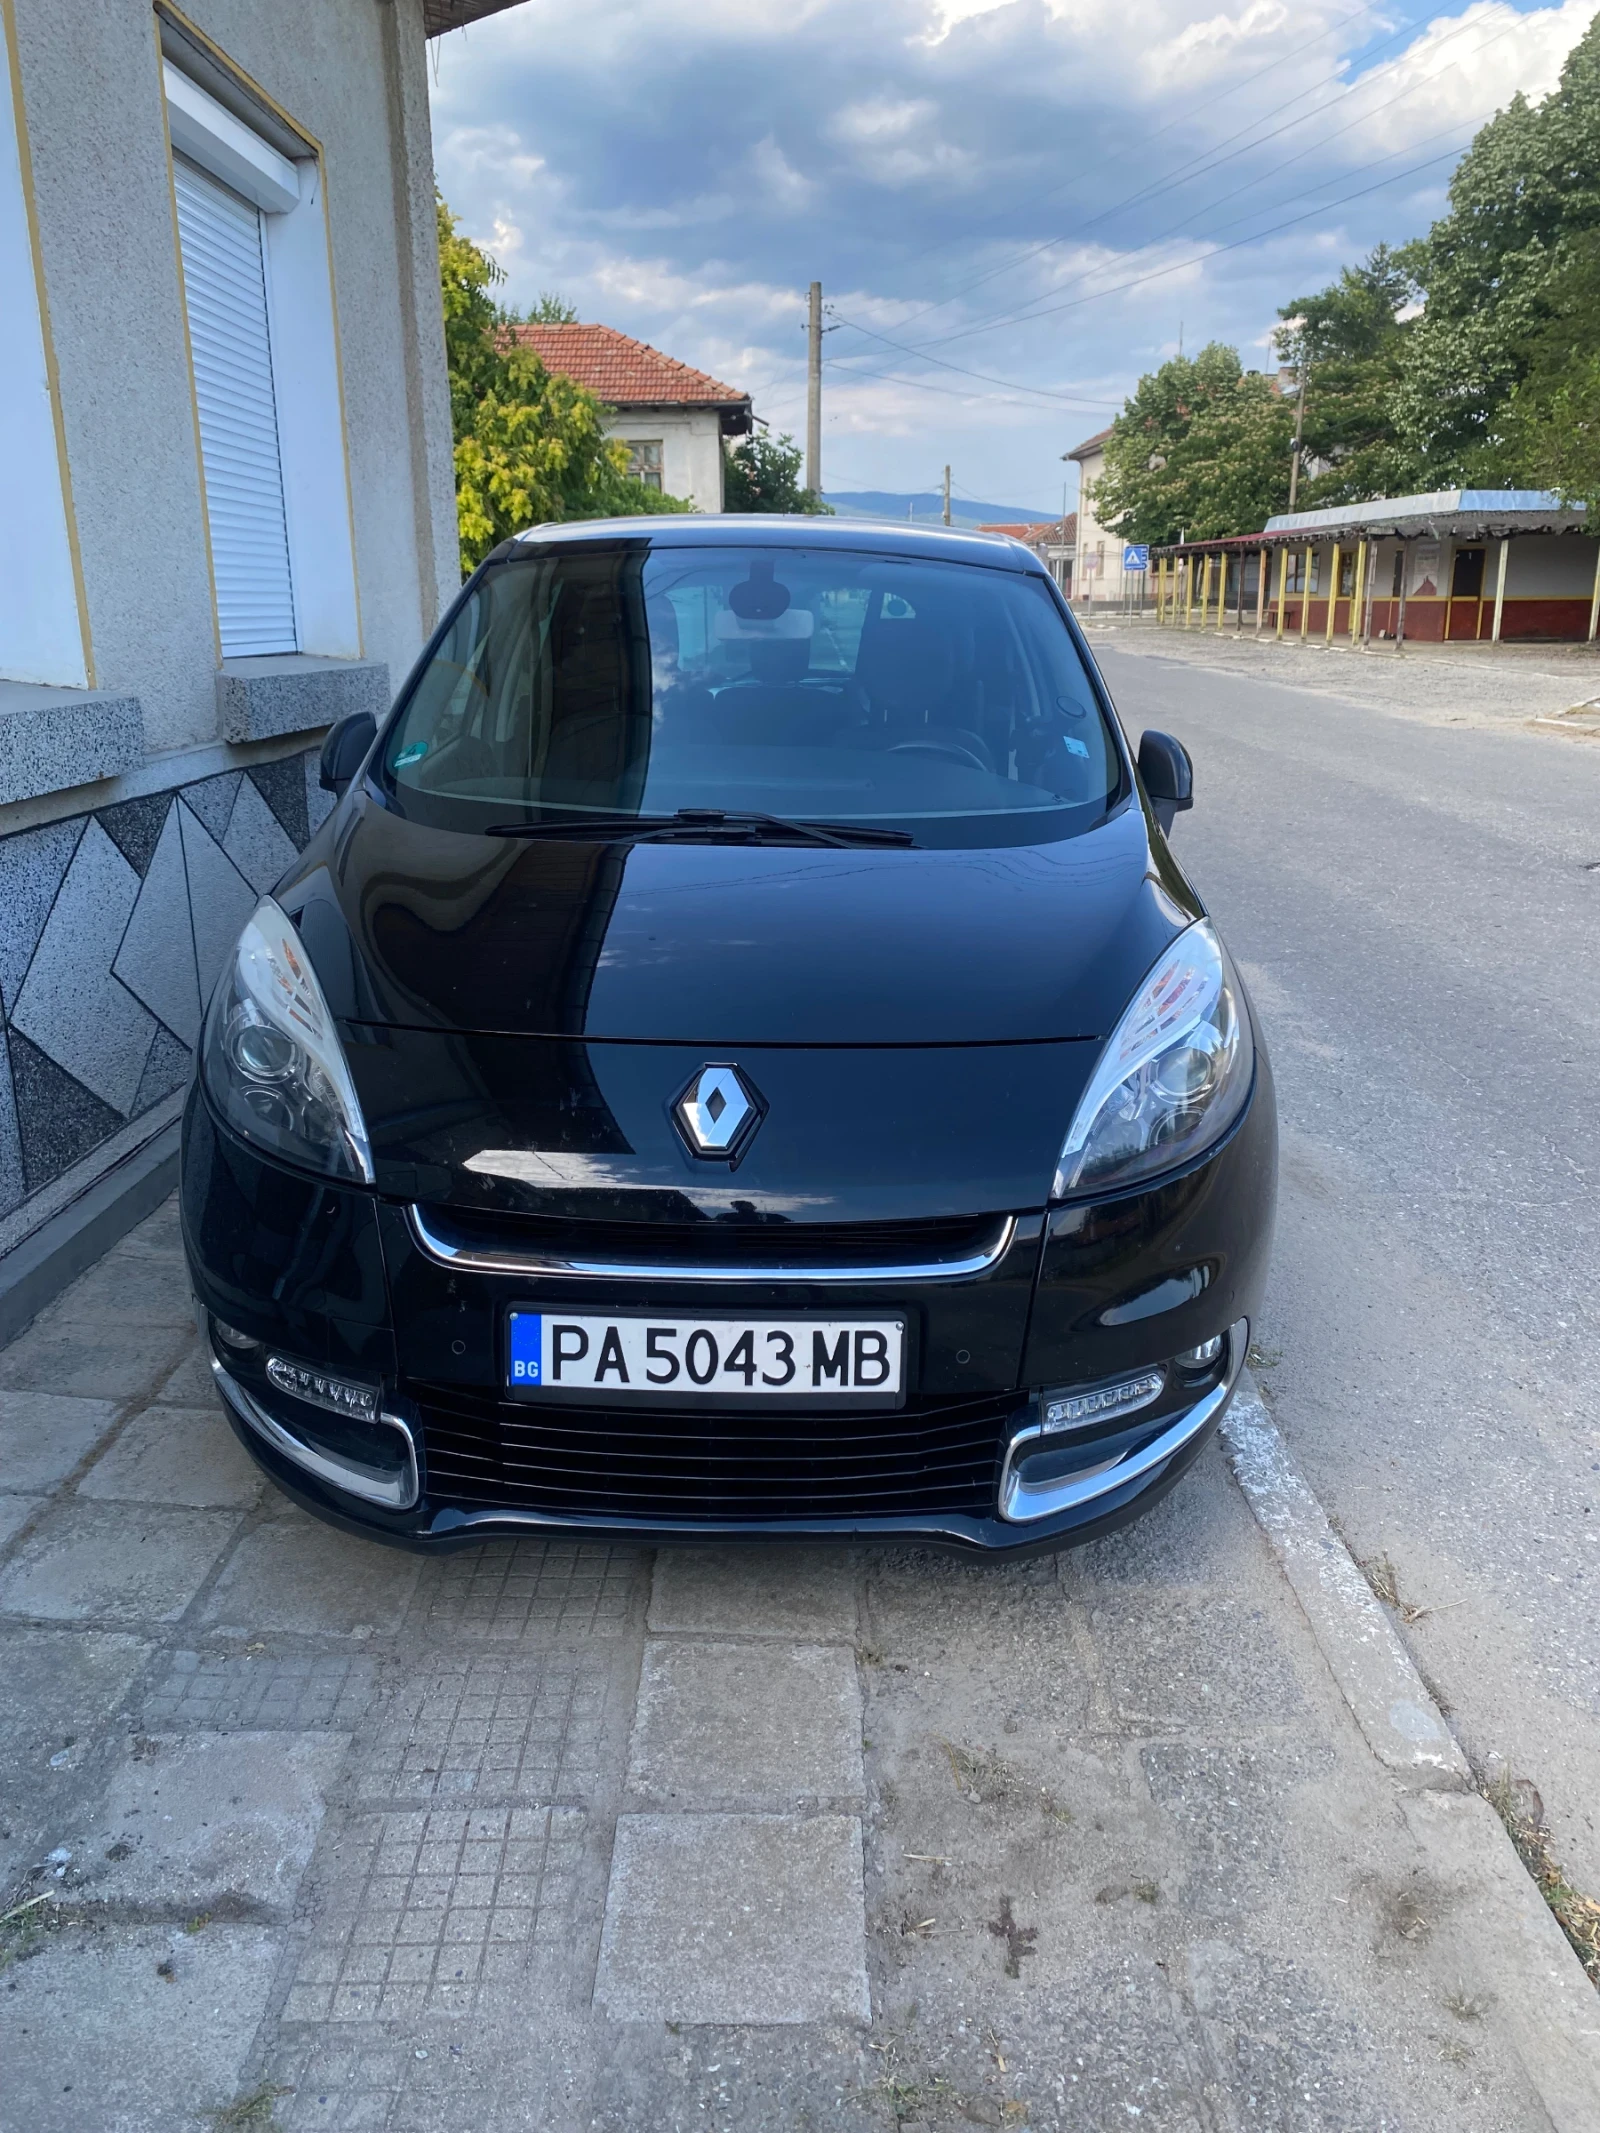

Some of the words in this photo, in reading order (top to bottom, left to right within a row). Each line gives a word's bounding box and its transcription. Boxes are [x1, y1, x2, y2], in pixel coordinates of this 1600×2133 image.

[514, 1360, 539, 1378] BG
[552, 1324, 631, 1384] PA
[646, 1327, 797, 1386] 5043
[812, 1330, 891, 1387] MB
